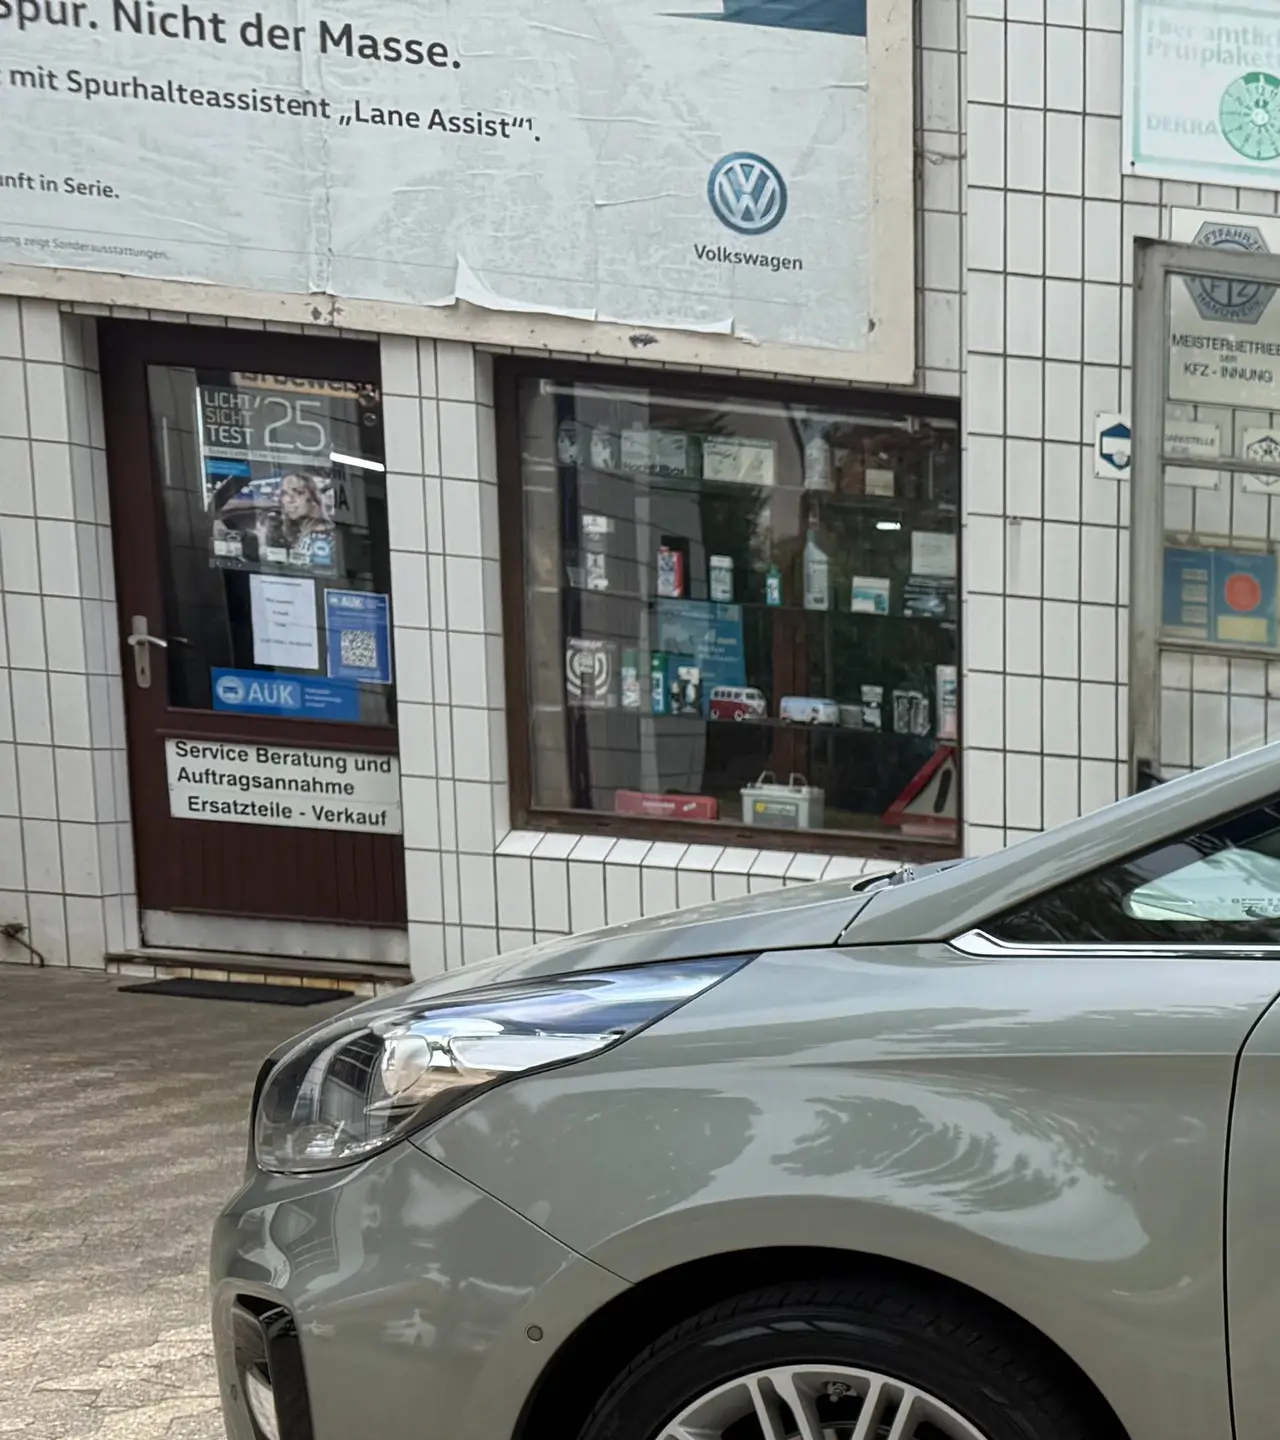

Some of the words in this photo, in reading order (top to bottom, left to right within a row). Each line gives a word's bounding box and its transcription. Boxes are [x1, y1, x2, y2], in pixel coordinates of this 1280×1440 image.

[113, 0, 226, 44] Nicht
[239, 13, 306, 52] der
[319, 20, 462, 69] Masse.
[10, 65, 58, 91] mit
[66, 69, 331, 119] Spurhalteassistent
[39, 174, 58, 192] in
[64, 176, 120, 199] Serie.
[693, 243, 804, 272] Volkswagen
[205, 424, 255, 445] TEST
[175, 740, 249, 762] Service
[255, 747, 348, 774] Beratung
[354, 756, 392, 773] und
[177, 766, 355, 795] Auftragsannahme
[188, 795, 293, 819] Ersatzteile
[312, 804, 387, 826] Verkauf
